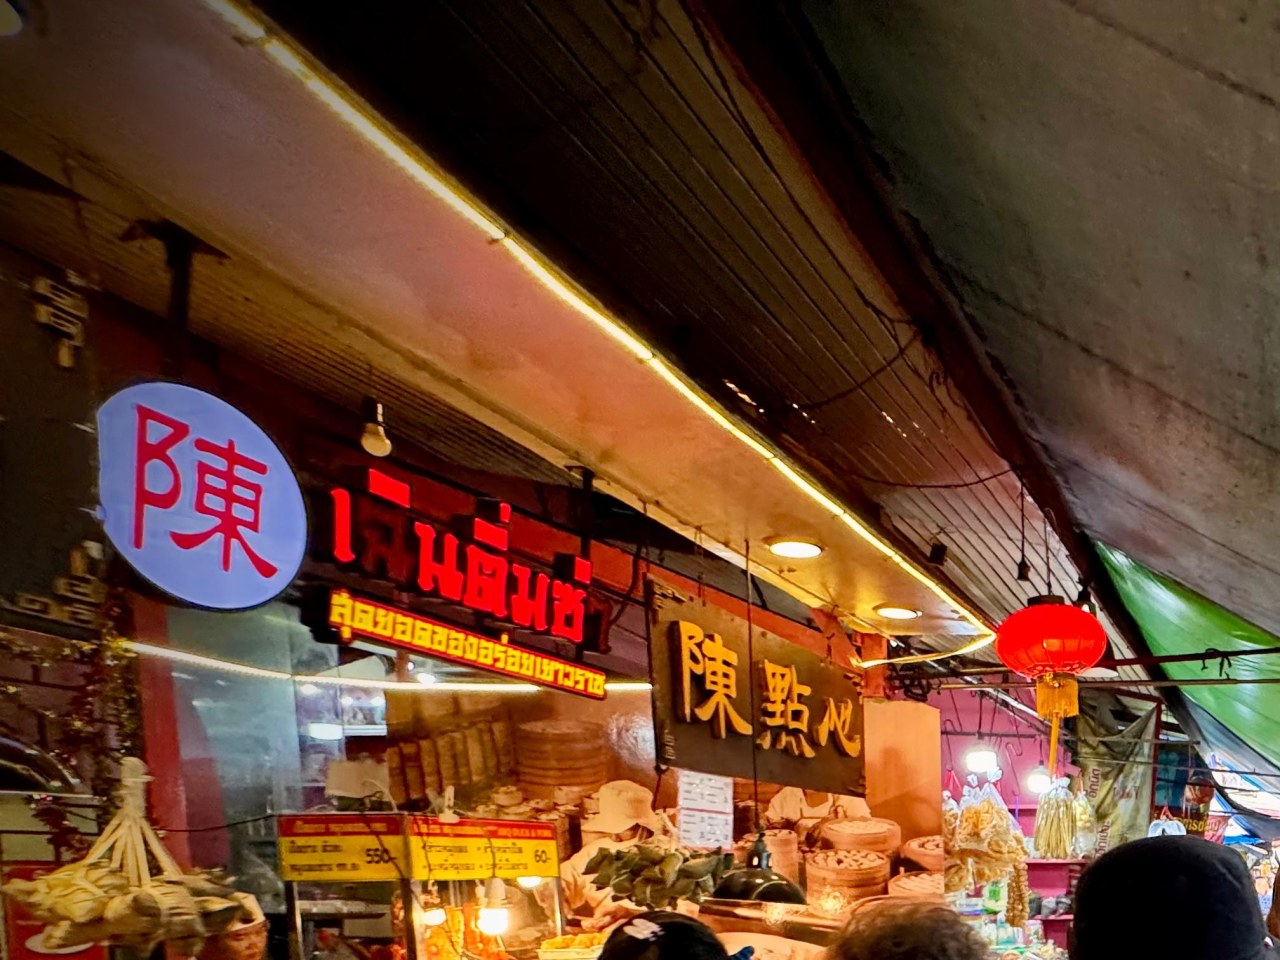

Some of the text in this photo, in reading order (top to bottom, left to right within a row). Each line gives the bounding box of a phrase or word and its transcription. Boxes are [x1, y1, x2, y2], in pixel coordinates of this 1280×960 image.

[134, 404, 279, 580] 陳
[672, 619, 862, 760] 陳點心
